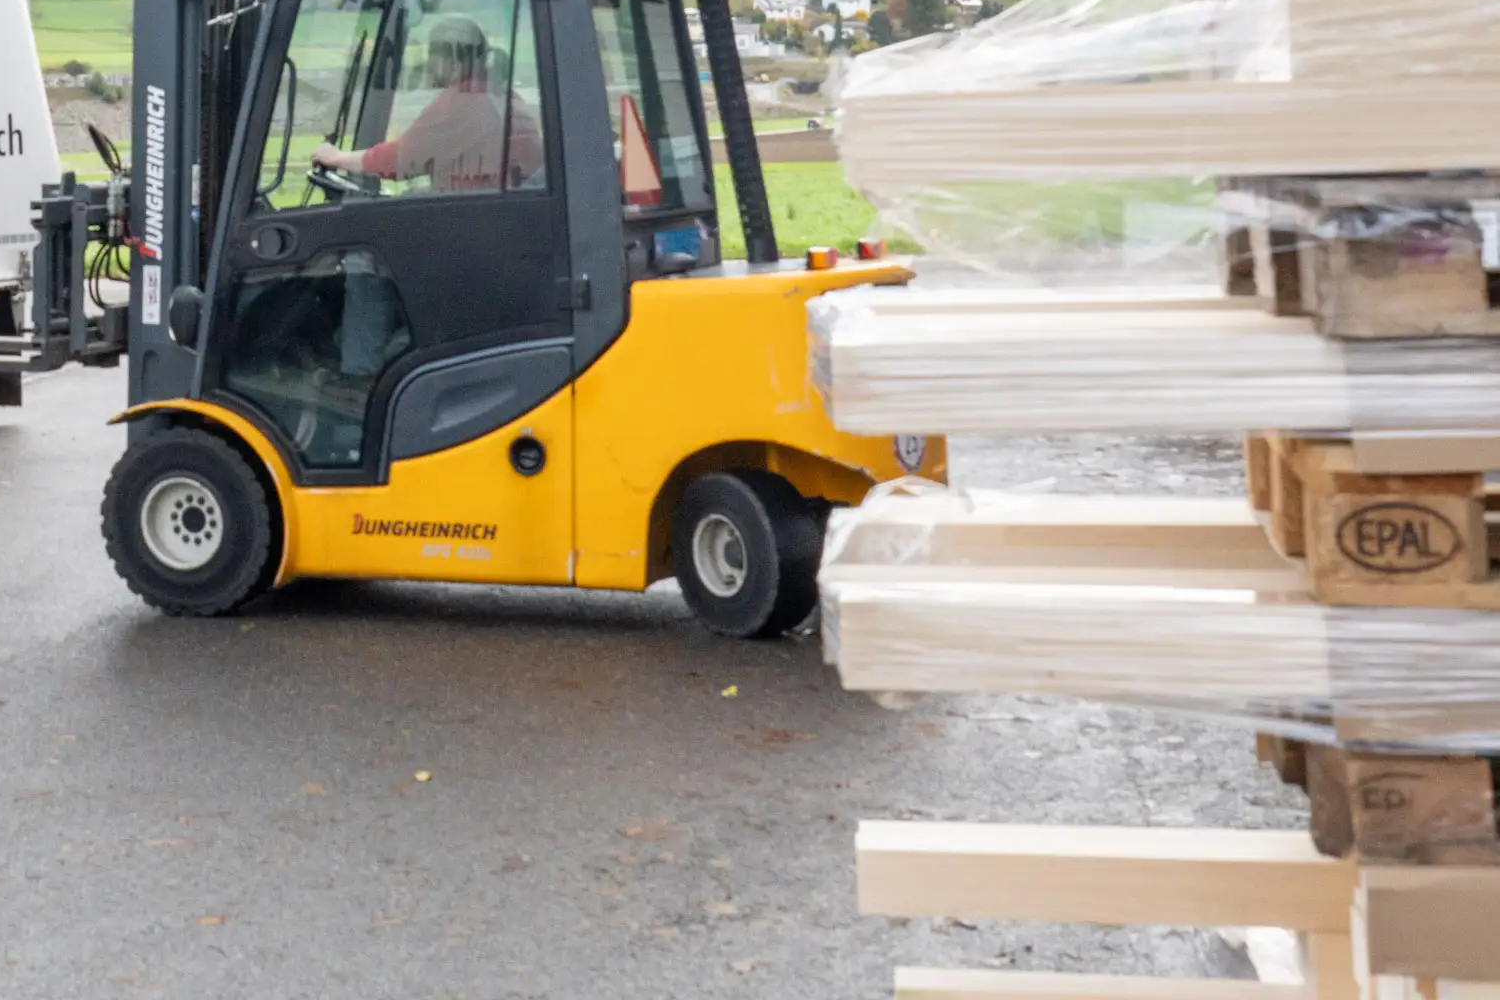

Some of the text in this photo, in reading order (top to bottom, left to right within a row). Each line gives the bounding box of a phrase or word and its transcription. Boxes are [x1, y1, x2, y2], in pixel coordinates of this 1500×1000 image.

[140, 85, 165, 260] JUNGHEINRICH
[352, 513, 498, 541] JUNGHEINRICH
[1356, 518, 1444, 557] EPAL
